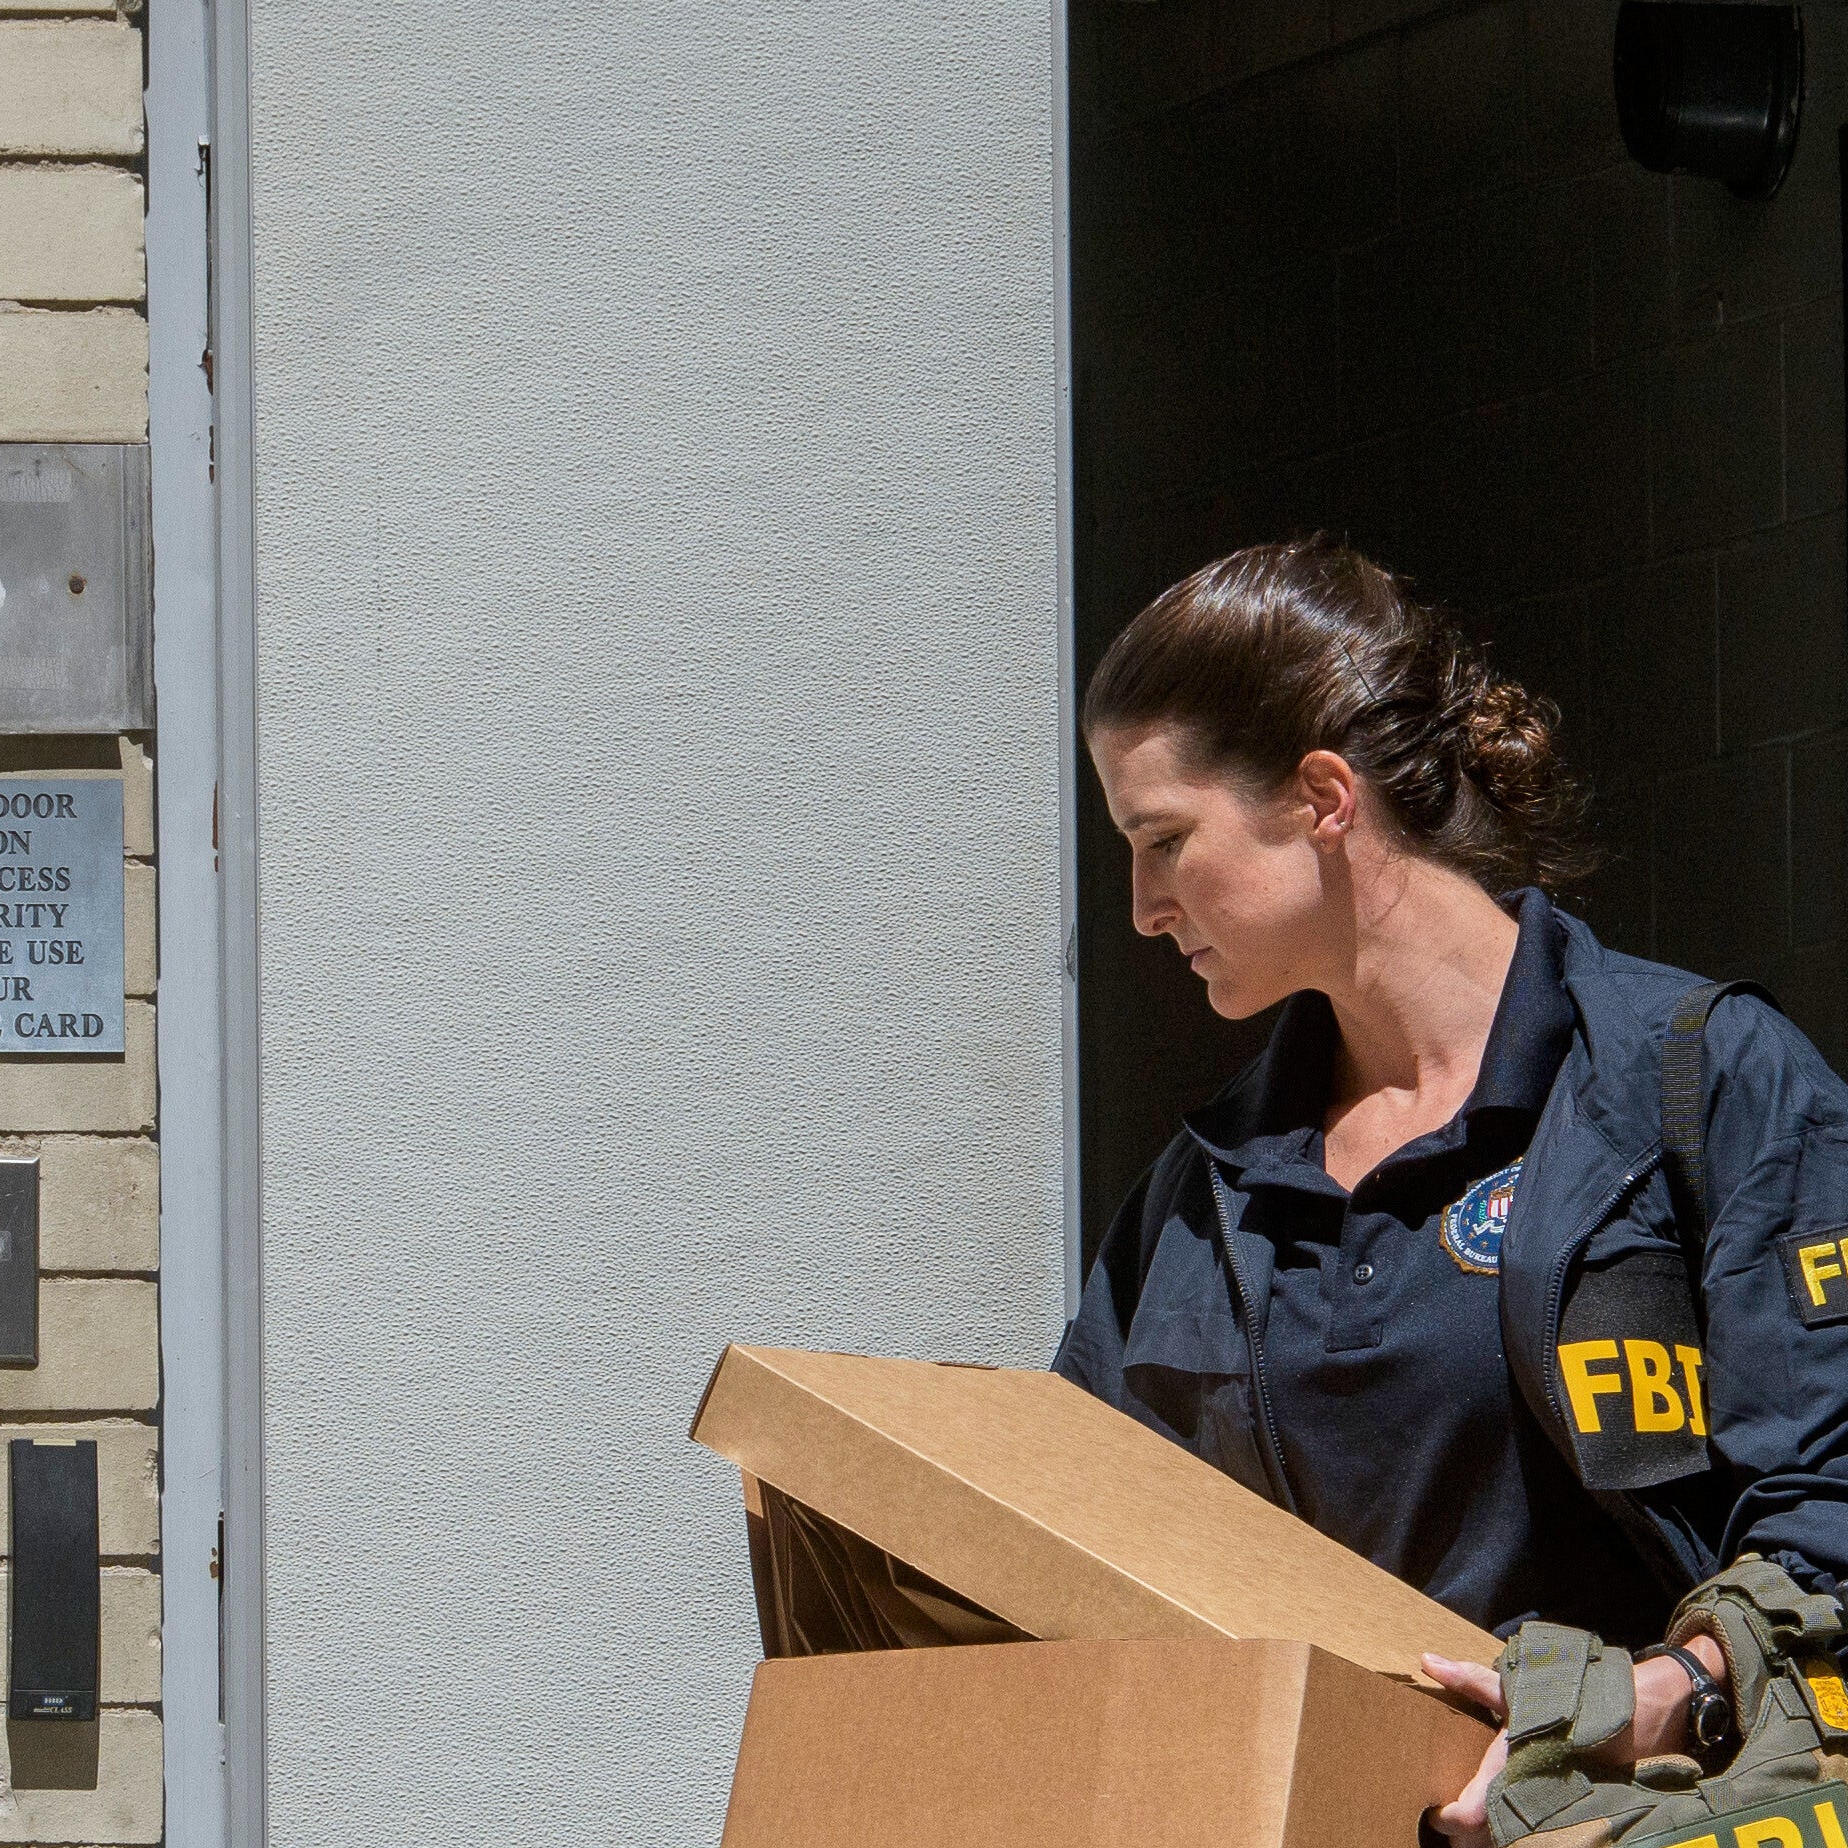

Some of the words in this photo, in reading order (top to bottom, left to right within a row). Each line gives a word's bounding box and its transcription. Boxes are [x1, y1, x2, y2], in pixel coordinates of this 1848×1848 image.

[27, 940, 85, 965] USE
[14, 1013, 104, 1038] CARD
[1558, 1339, 1708, 1436] FBI
